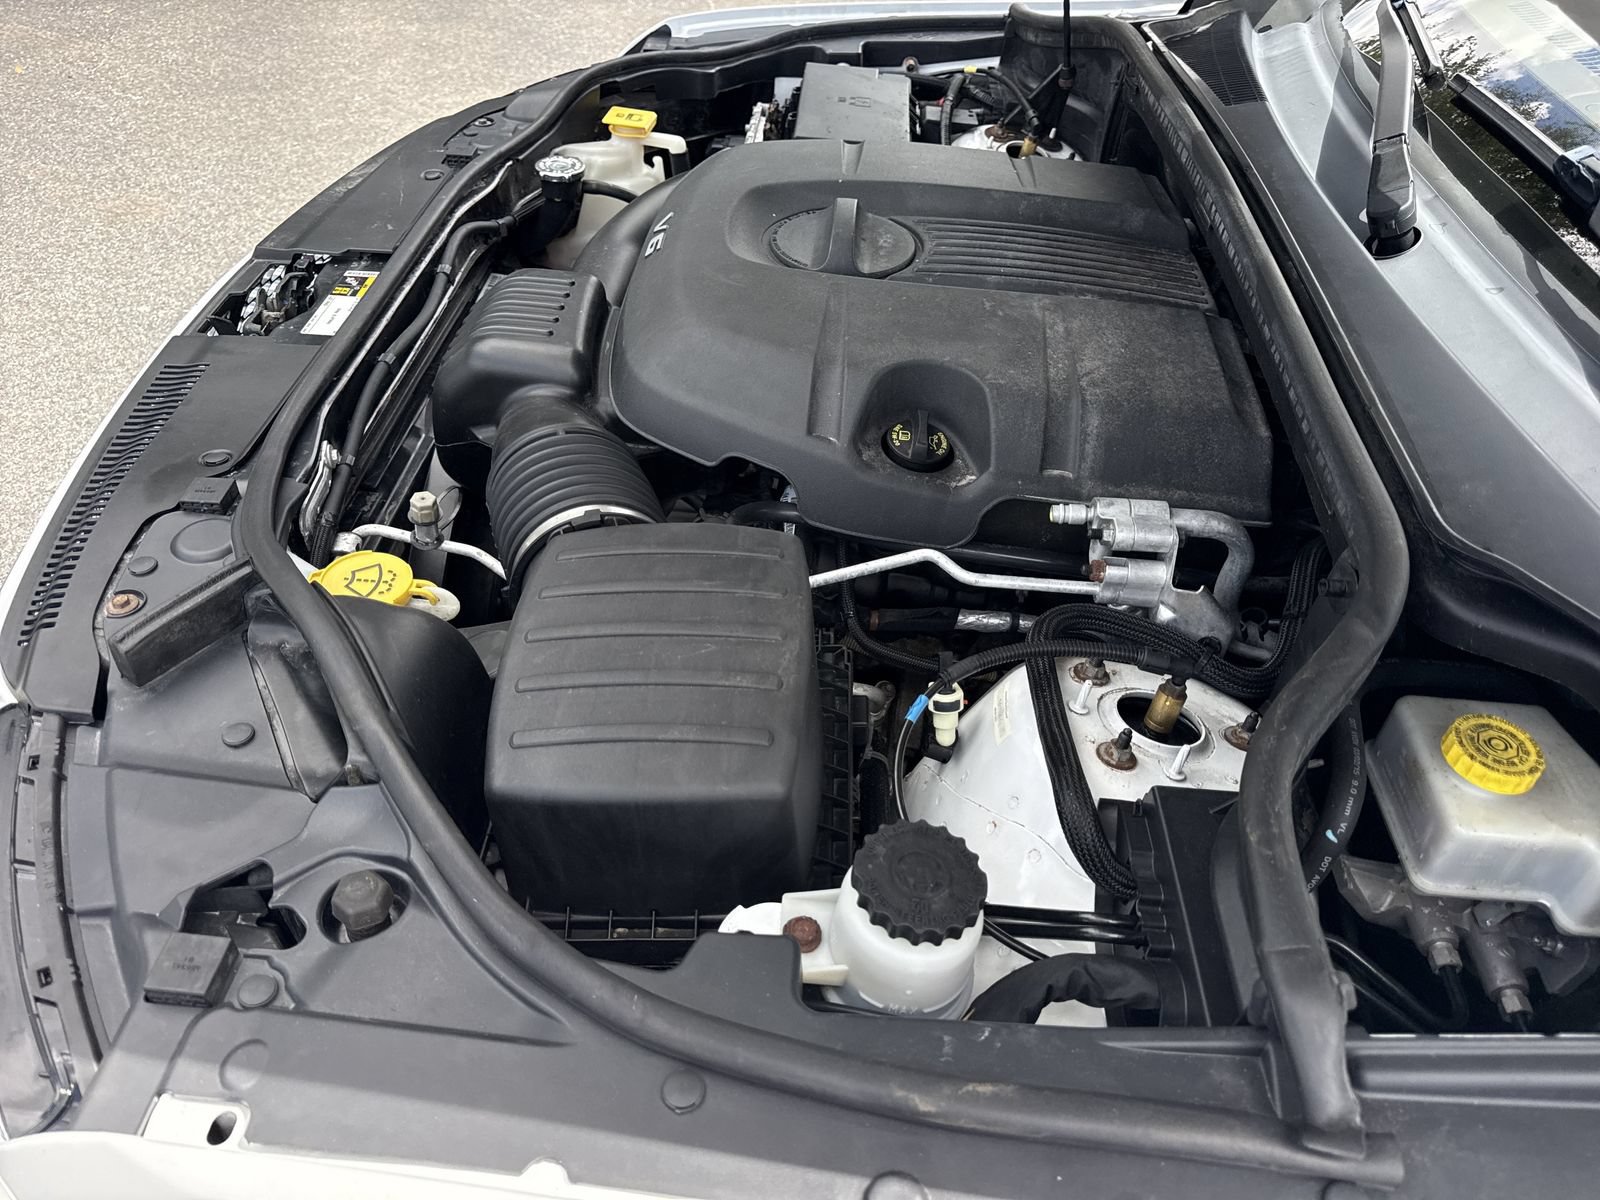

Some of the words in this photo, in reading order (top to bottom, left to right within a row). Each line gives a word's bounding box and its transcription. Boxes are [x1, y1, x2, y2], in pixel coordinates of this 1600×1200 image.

[645, 211, 675, 257] V6
[1350, 780, 1359, 794] 9.0
[1344, 797, 1354, 816] mm
[1337, 823, 1347, 834] VL
[1320, 856, 1332, 872] DOT
[1307, 874, 1320, 890] AVO
[888, 1003, 918, 1015] MAX
